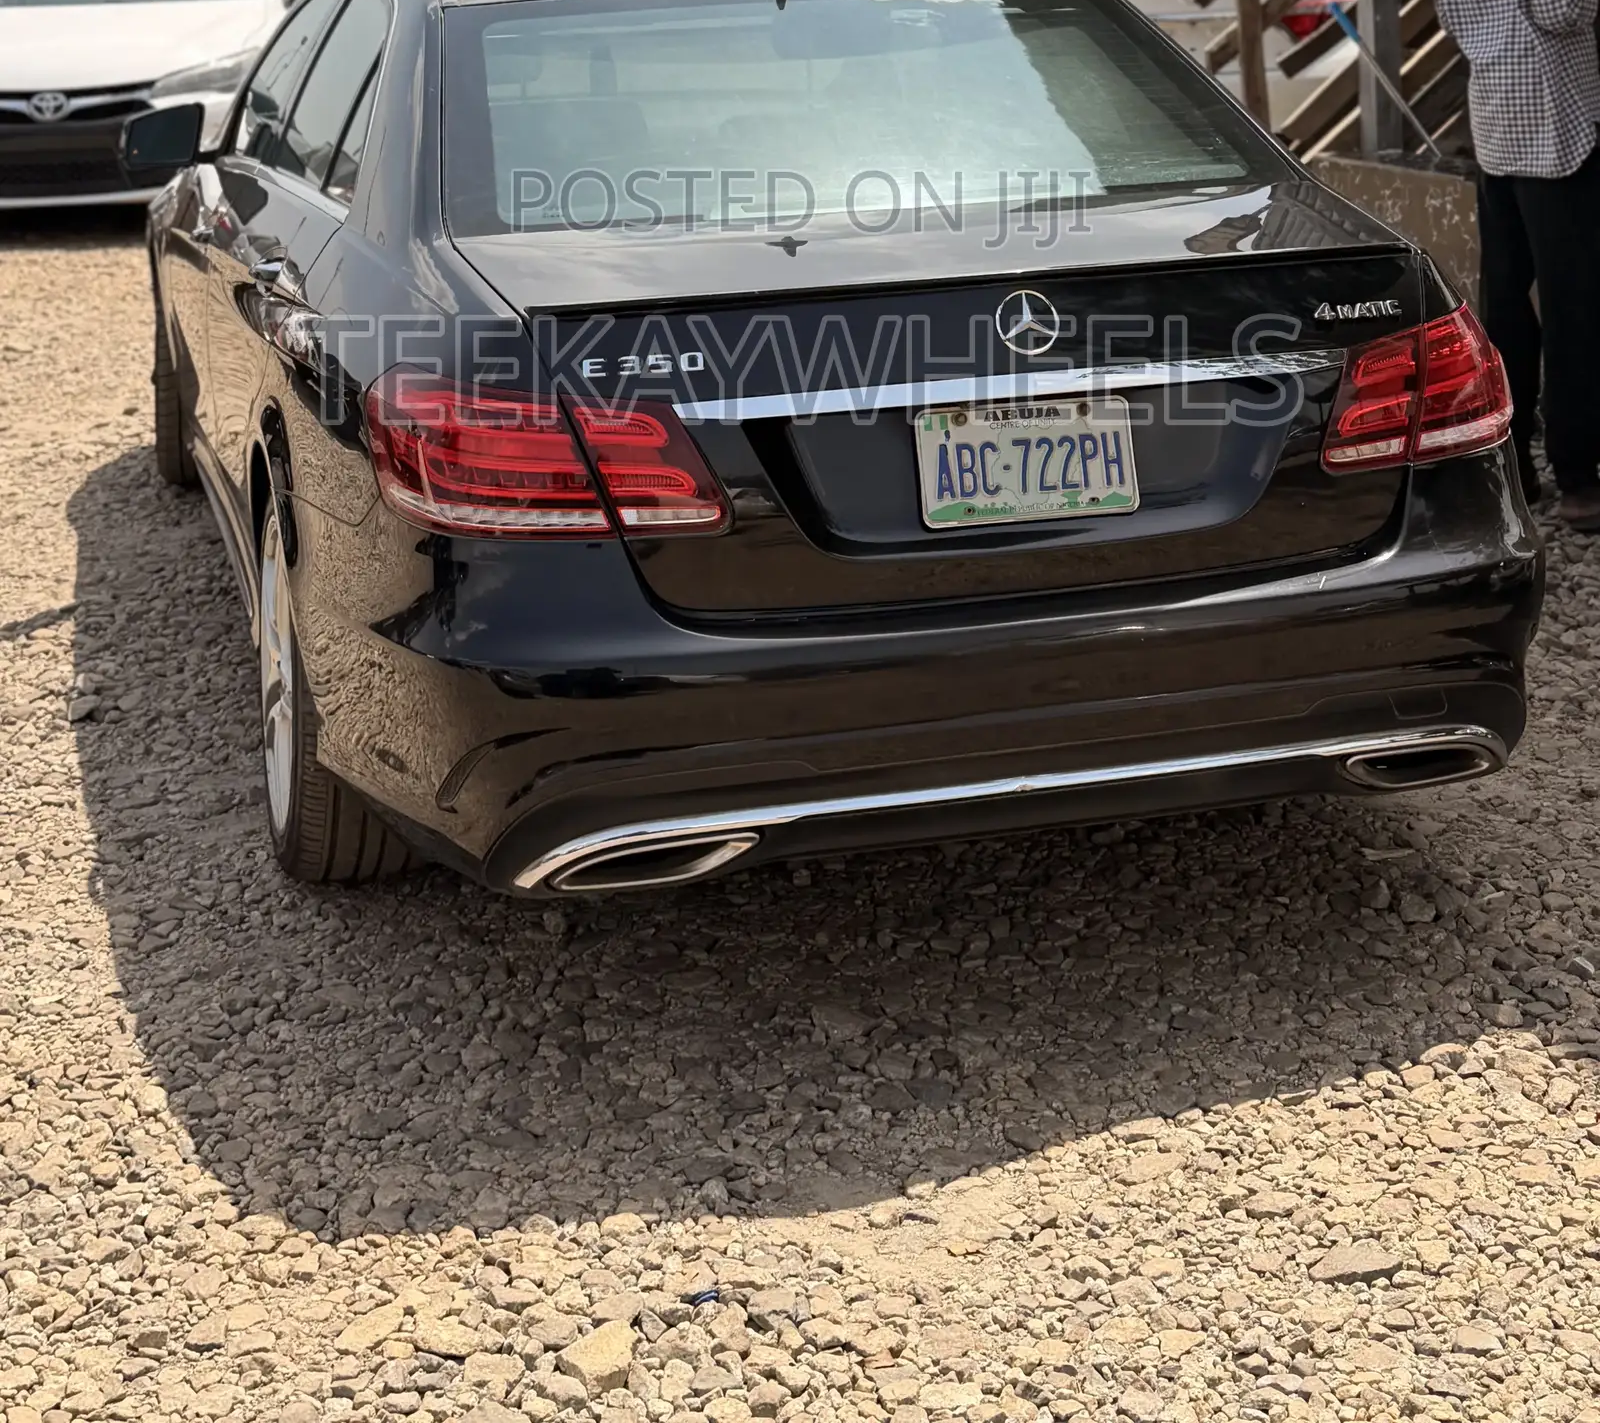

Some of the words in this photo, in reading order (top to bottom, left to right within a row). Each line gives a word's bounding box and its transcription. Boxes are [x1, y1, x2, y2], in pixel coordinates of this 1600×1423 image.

[583, 358, 608, 378] E
[618, 352, 704, 375] 350
[984, 406, 1060, 422] ABUJA
[937, 431, 1125, 500] ABC-722PH
